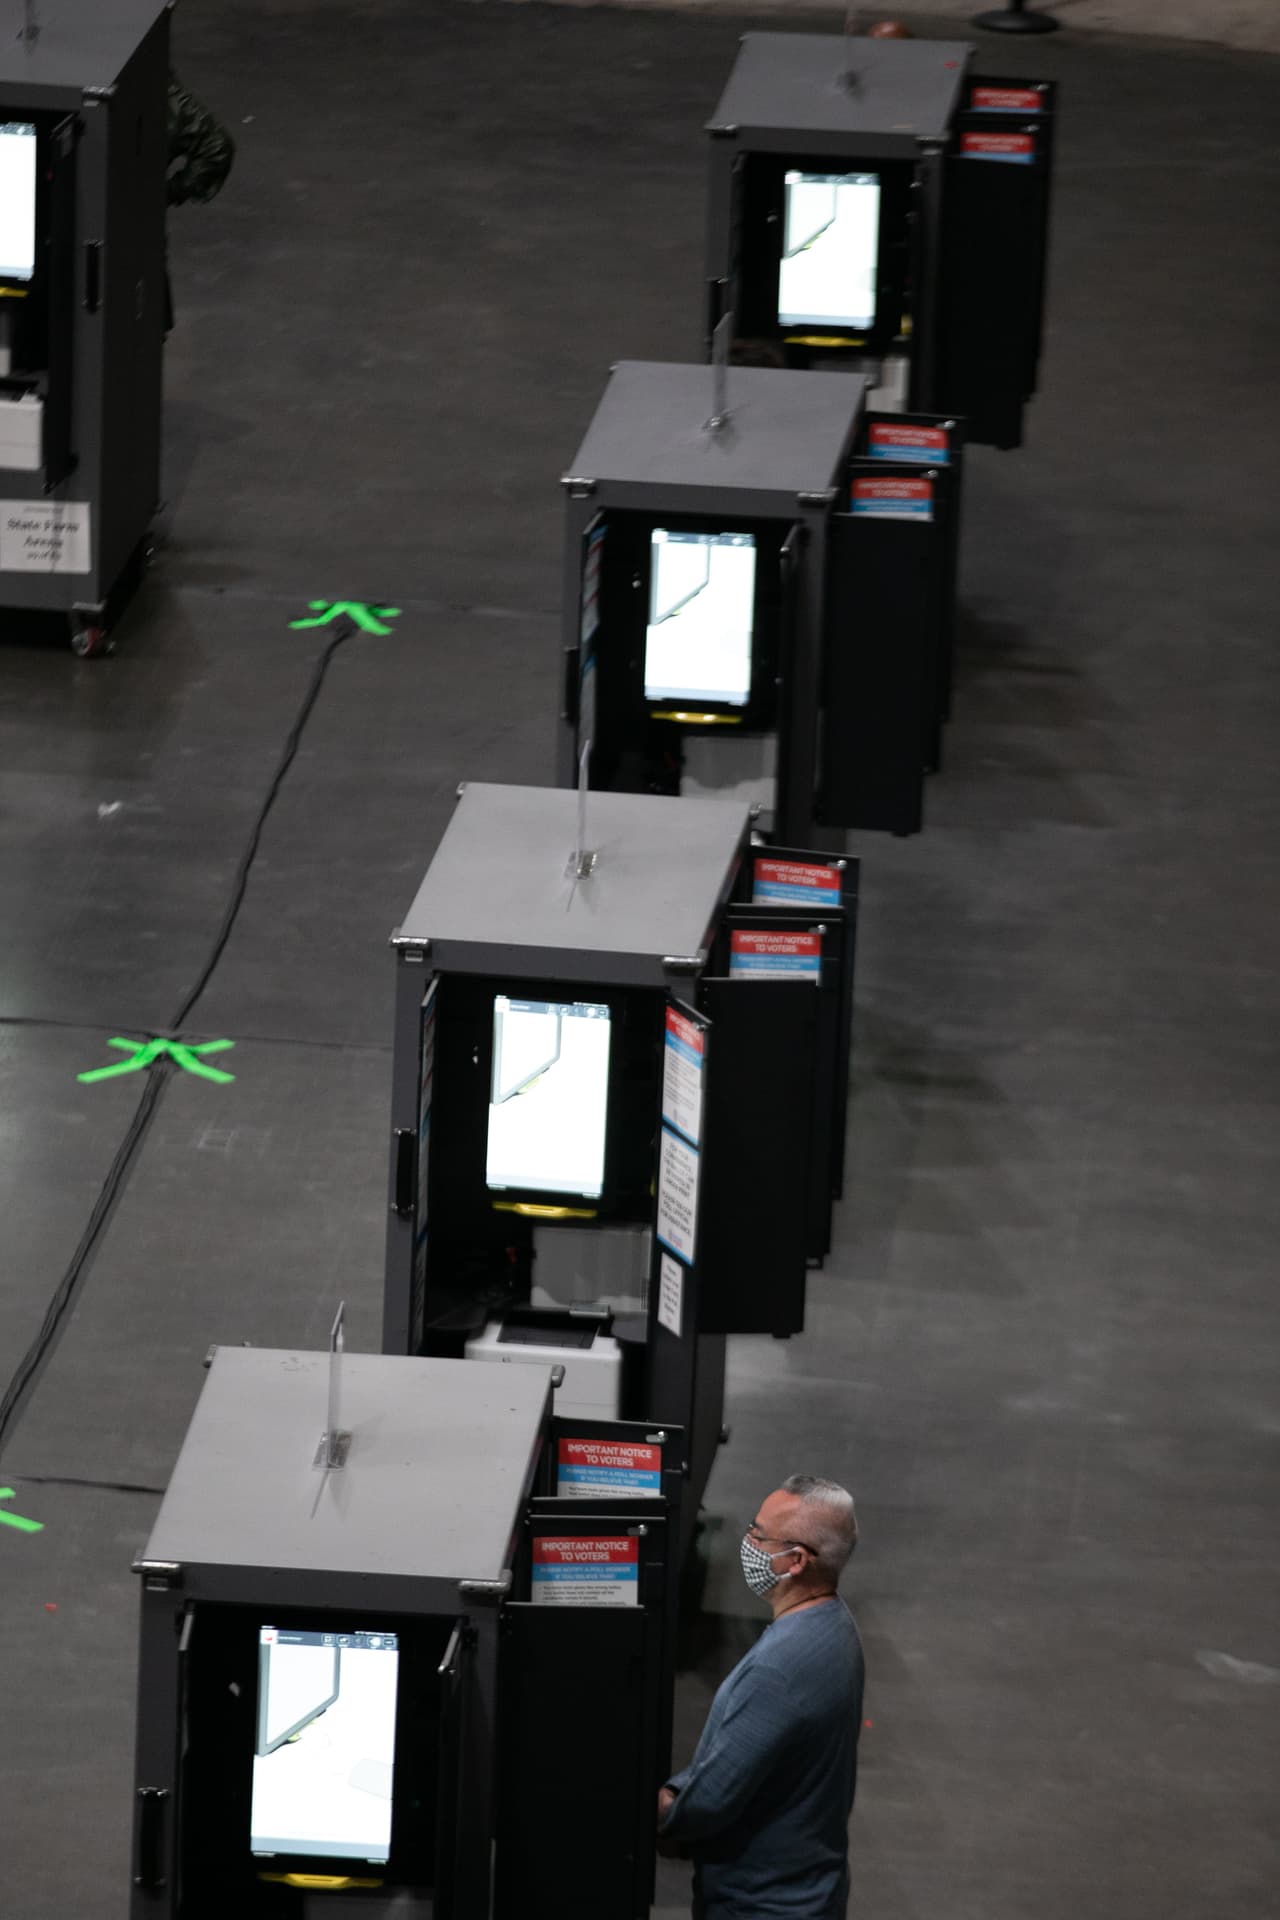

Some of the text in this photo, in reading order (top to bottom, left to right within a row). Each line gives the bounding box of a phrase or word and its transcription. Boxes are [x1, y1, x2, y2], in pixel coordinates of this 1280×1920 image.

[762, 863, 804, 874] IMPORTANT
[776, 872, 817, 885] TO VOTERS
[740, 935, 814, 945] IMPORTANT NOTICE
[756, 943, 797, 953] TO VOTERS
[567, 1444, 652, 1458] IMPORTANT NOTICE
[586, 1454, 634, 1466] TO VOTERS
[543, 1541, 629, 1551] IMPORTANT NOTICE
[561, 1551, 610, 1560] TO VOTERS
